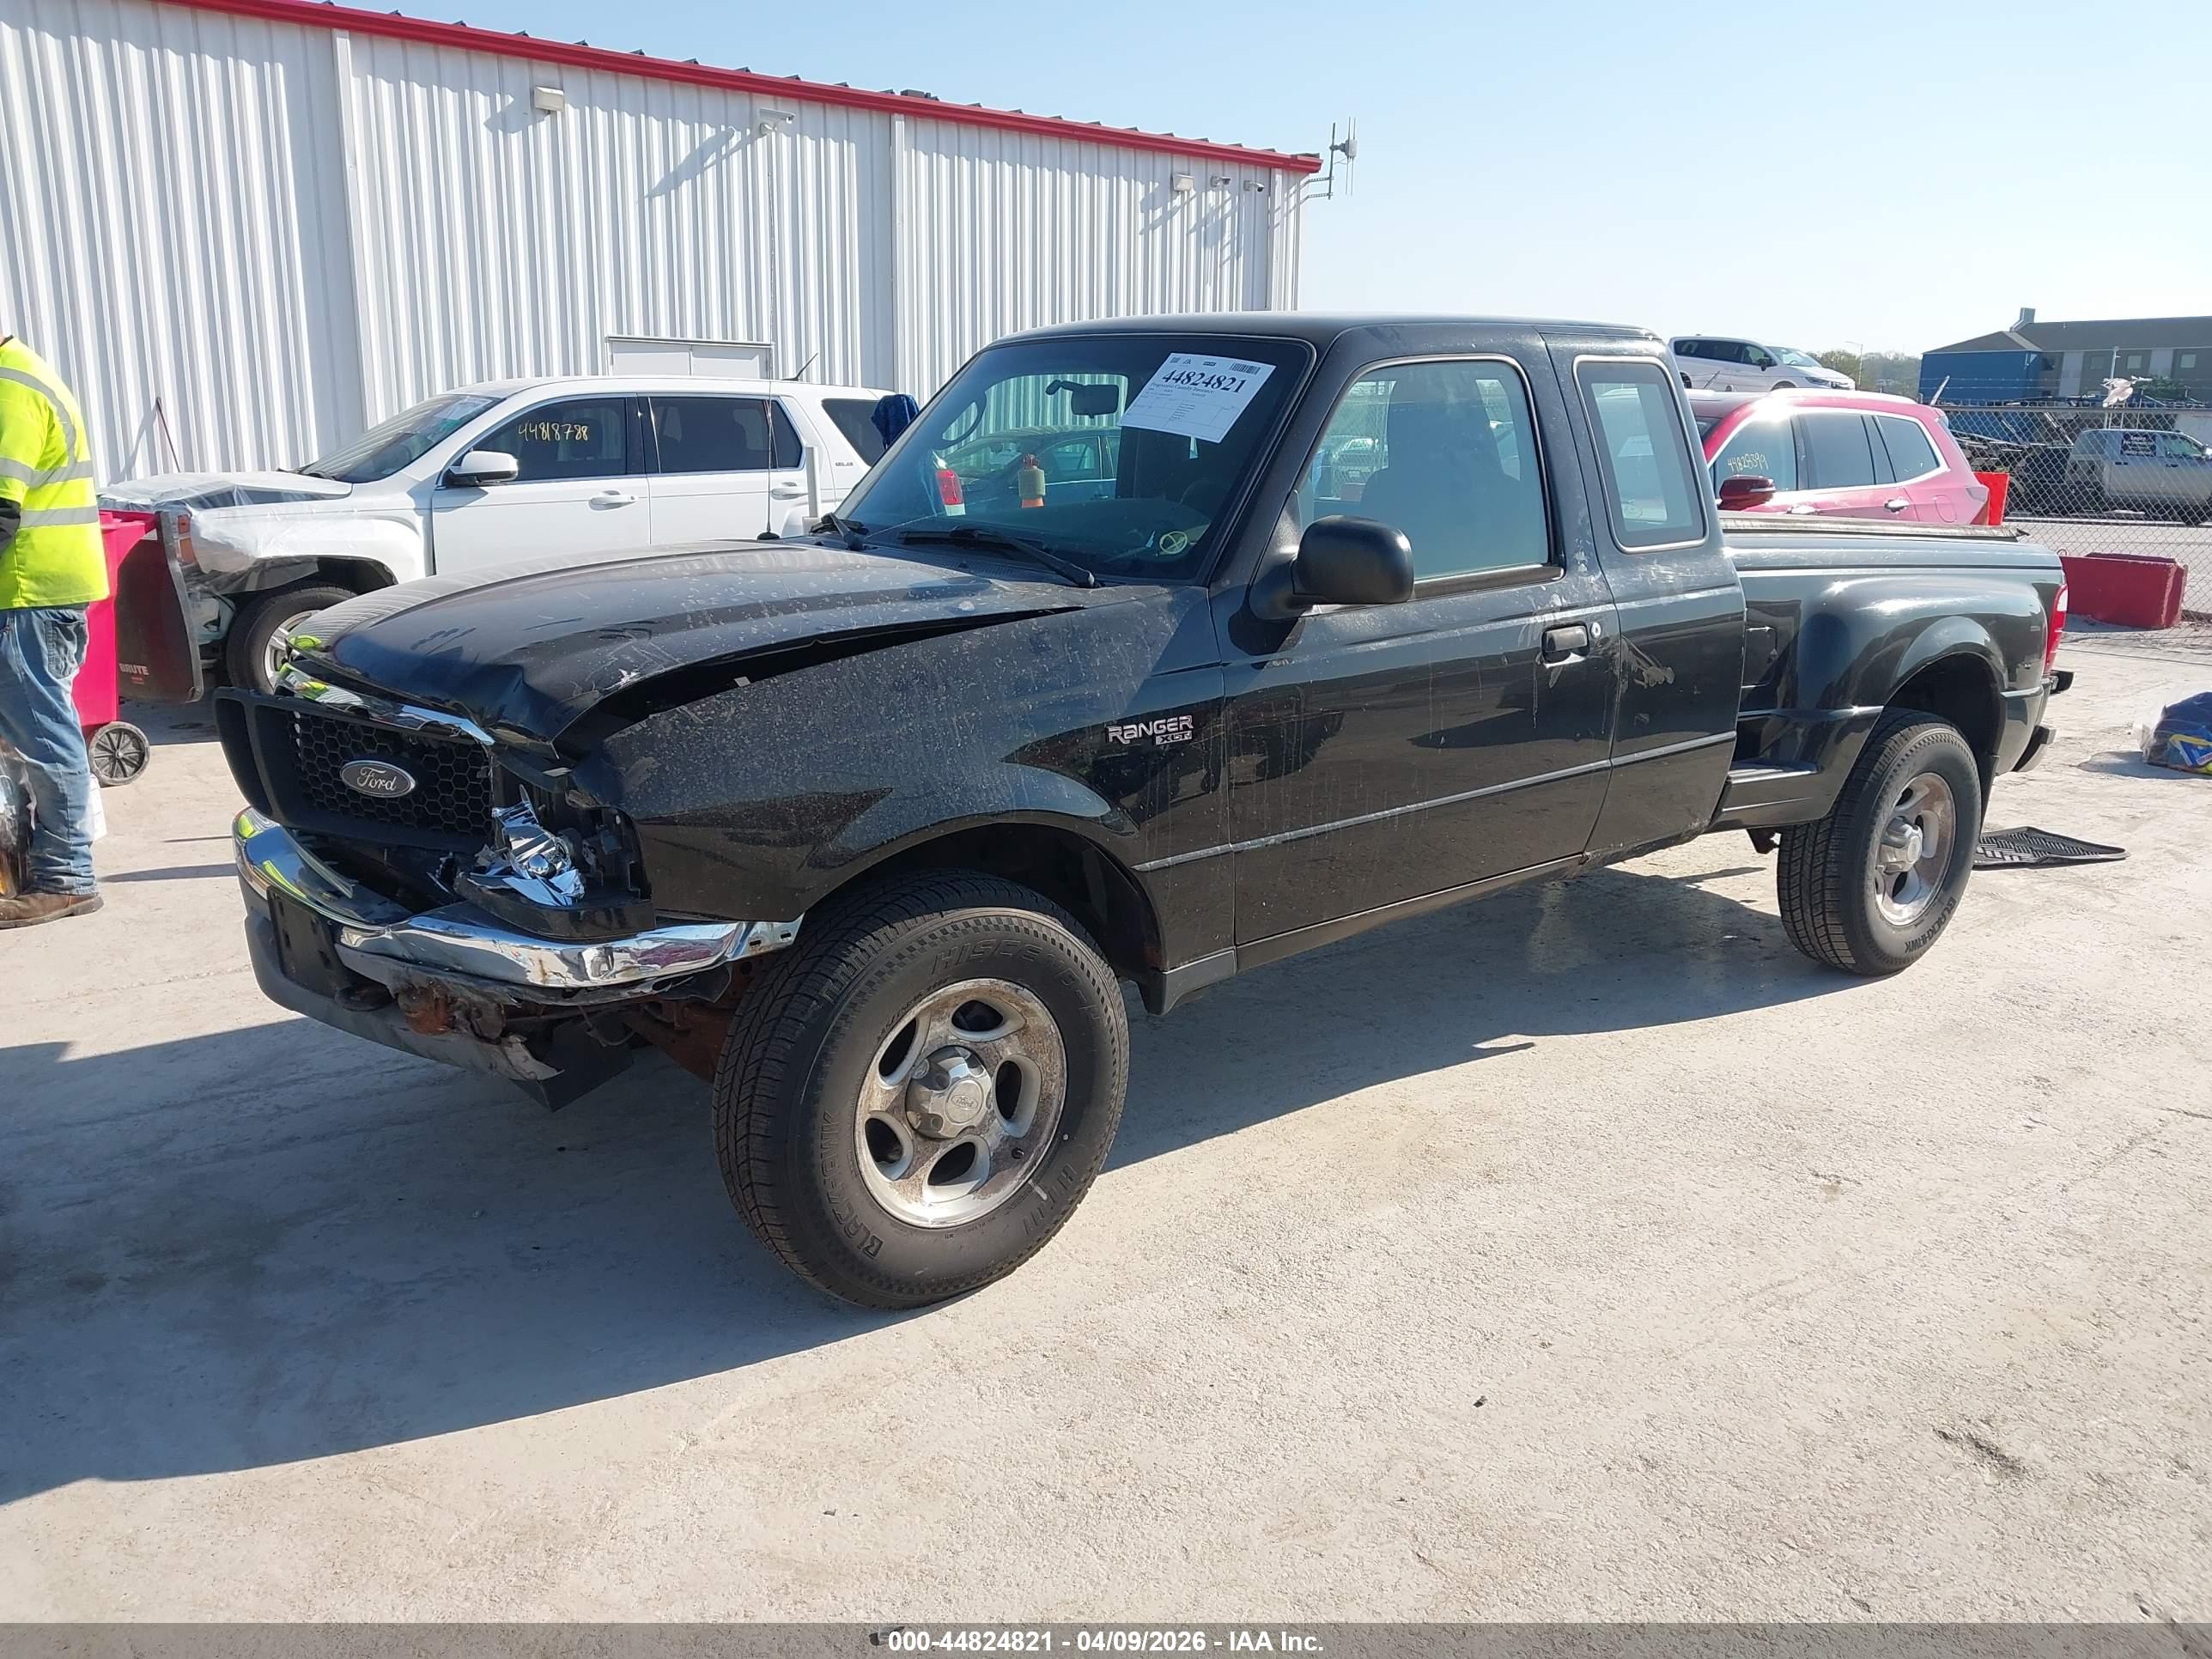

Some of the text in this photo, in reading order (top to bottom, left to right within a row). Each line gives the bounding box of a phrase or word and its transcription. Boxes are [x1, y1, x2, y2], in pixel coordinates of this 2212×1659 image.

[1162, 369, 1247, 392] 44824821
[518, 422, 588, 441] 44818788
[118, 663, 149, 675] BRUTE
[1107, 714, 1194, 744] RANGER
[356, 767, 398, 791] Ford
[1904, 896, 1957, 954] BLACKHAWK
